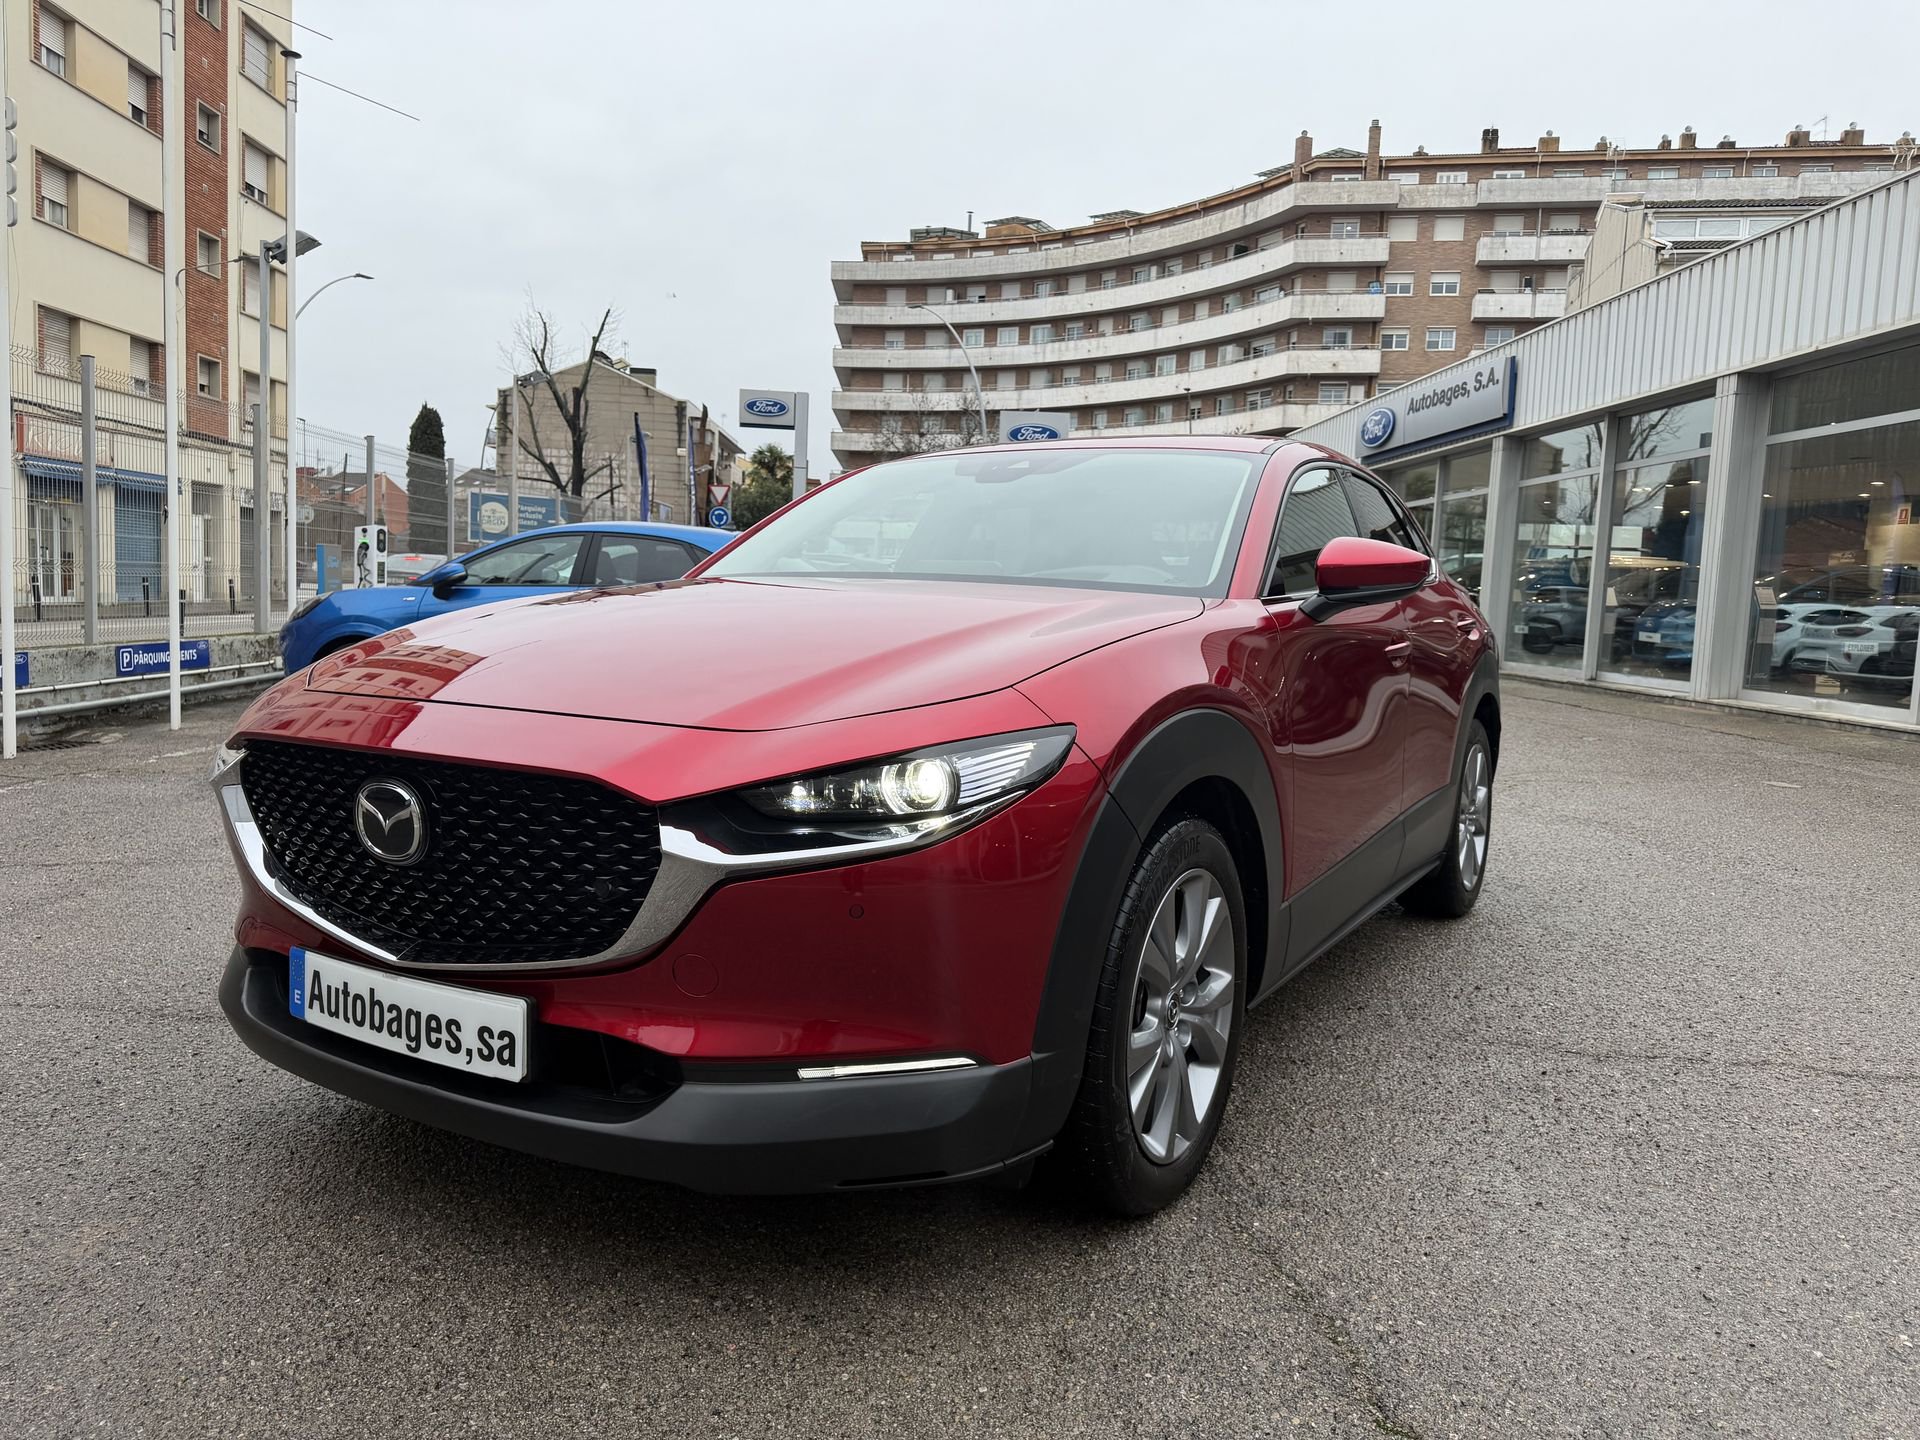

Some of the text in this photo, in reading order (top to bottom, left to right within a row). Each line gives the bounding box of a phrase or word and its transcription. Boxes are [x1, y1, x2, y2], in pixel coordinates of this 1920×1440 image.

[1406, 367, 1500, 416] Autobages, S.A.
[753, 400, 781, 414] Ford
[1016, 425, 1051, 441] Ford
[1364, 414, 1386, 441] Ford
[134, 650, 170, 667] PÀRQUING
[294, 969, 516, 1068] E Autobages,sa
